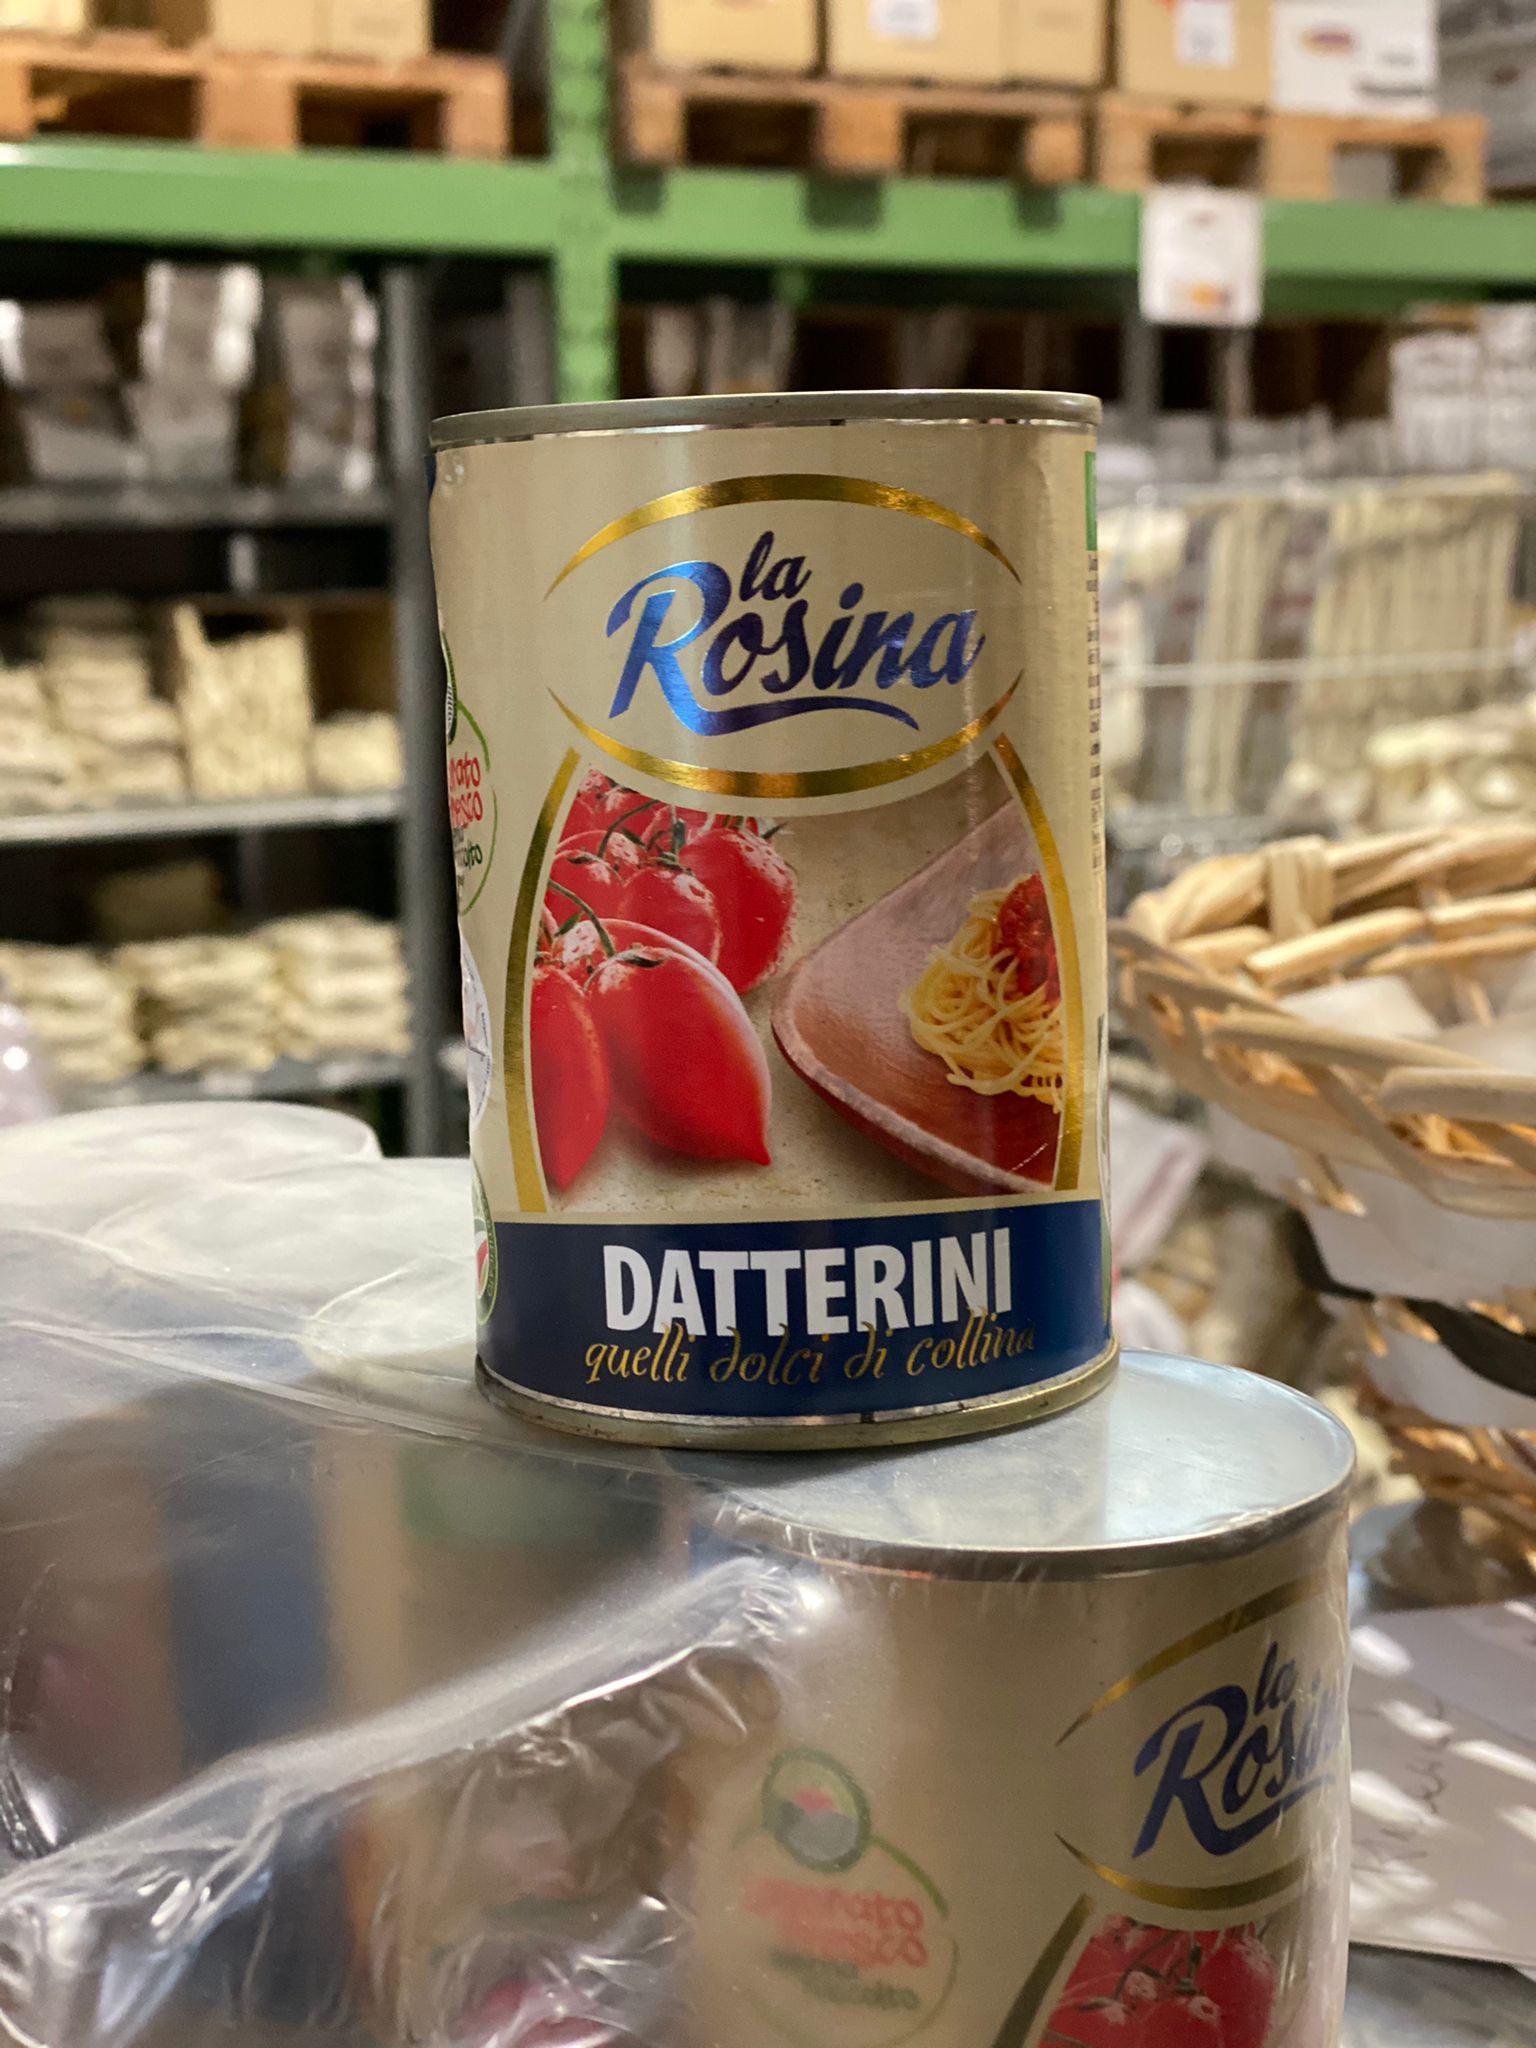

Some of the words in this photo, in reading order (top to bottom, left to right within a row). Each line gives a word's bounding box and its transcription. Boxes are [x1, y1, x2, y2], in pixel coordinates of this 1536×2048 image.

[739, 531, 811, 601] la
[606, 560, 986, 736] Rosina
[603, 1227, 1011, 1337] DATTERINI
[584, 1322, 695, 1385] quelli
[709, 1322, 829, 1386] dolci
[842, 1321, 894, 1380] di
[906, 1305, 1036, 1377] collina
[1254, 1641, 1298, 1716] la
